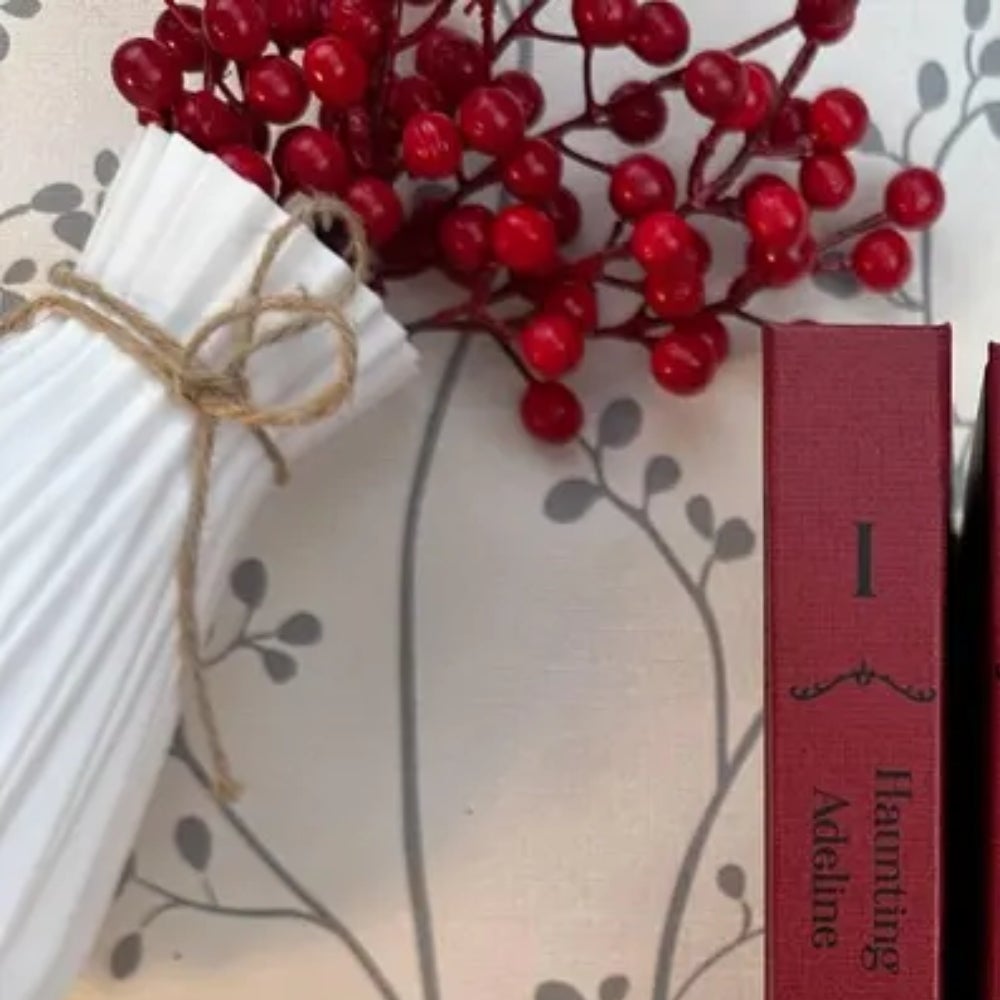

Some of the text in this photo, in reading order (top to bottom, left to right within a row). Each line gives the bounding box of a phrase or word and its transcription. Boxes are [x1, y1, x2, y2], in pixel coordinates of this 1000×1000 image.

[852, 521, 875, 599] I
[811, 787, 851, 950] Adeline
[861, 768, 913, 973] Haunting
